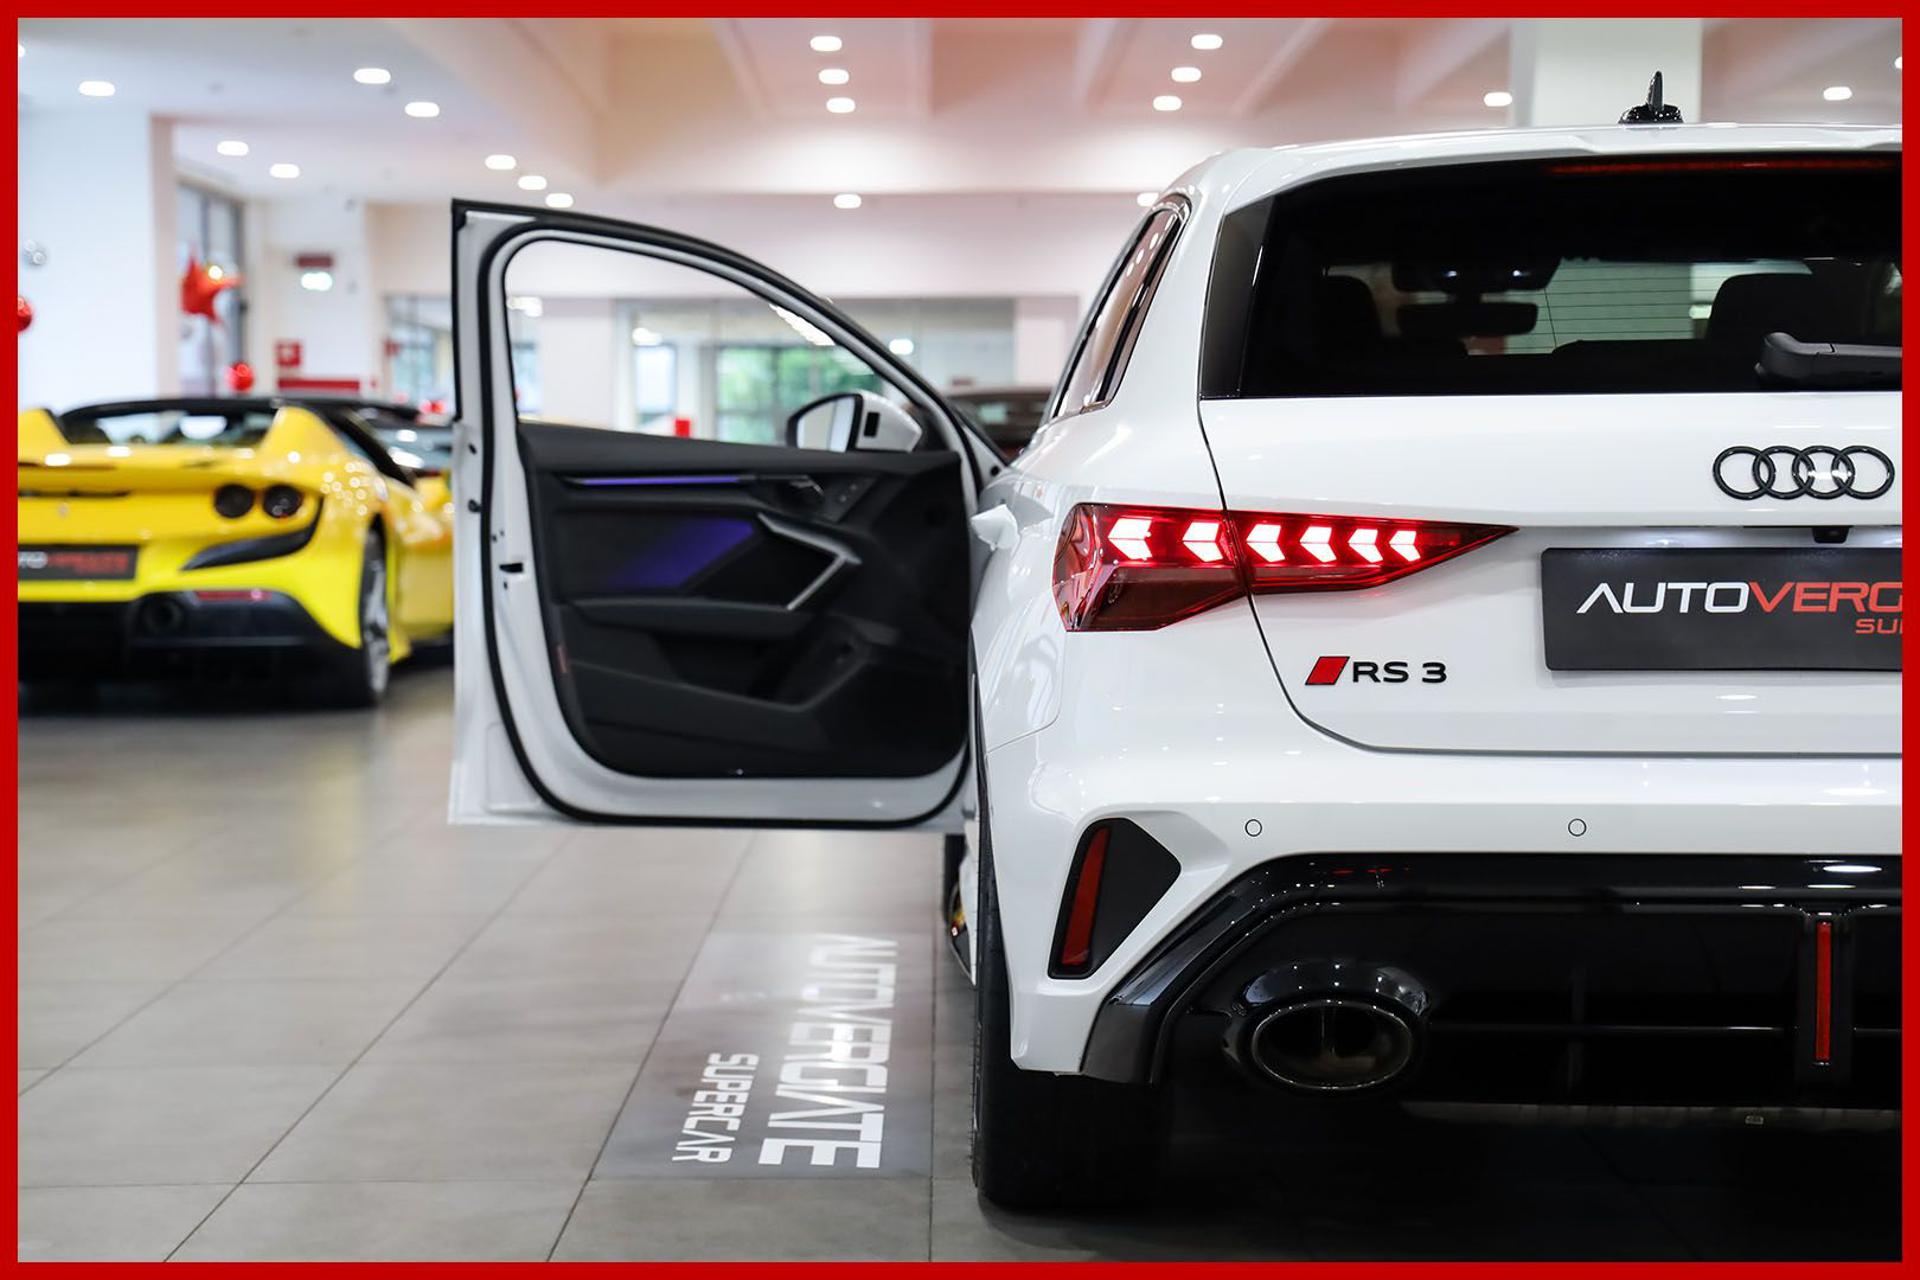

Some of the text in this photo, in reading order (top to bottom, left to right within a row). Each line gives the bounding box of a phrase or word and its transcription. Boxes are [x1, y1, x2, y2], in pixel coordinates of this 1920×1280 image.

[1855, 618, 1903, 634] SU
[1352, 661, 1448, 684] RS 3
[757, 933, 899, 1168] AUTOVERGIATE
[671, 1052, 760, 1163] SUPERCAR
